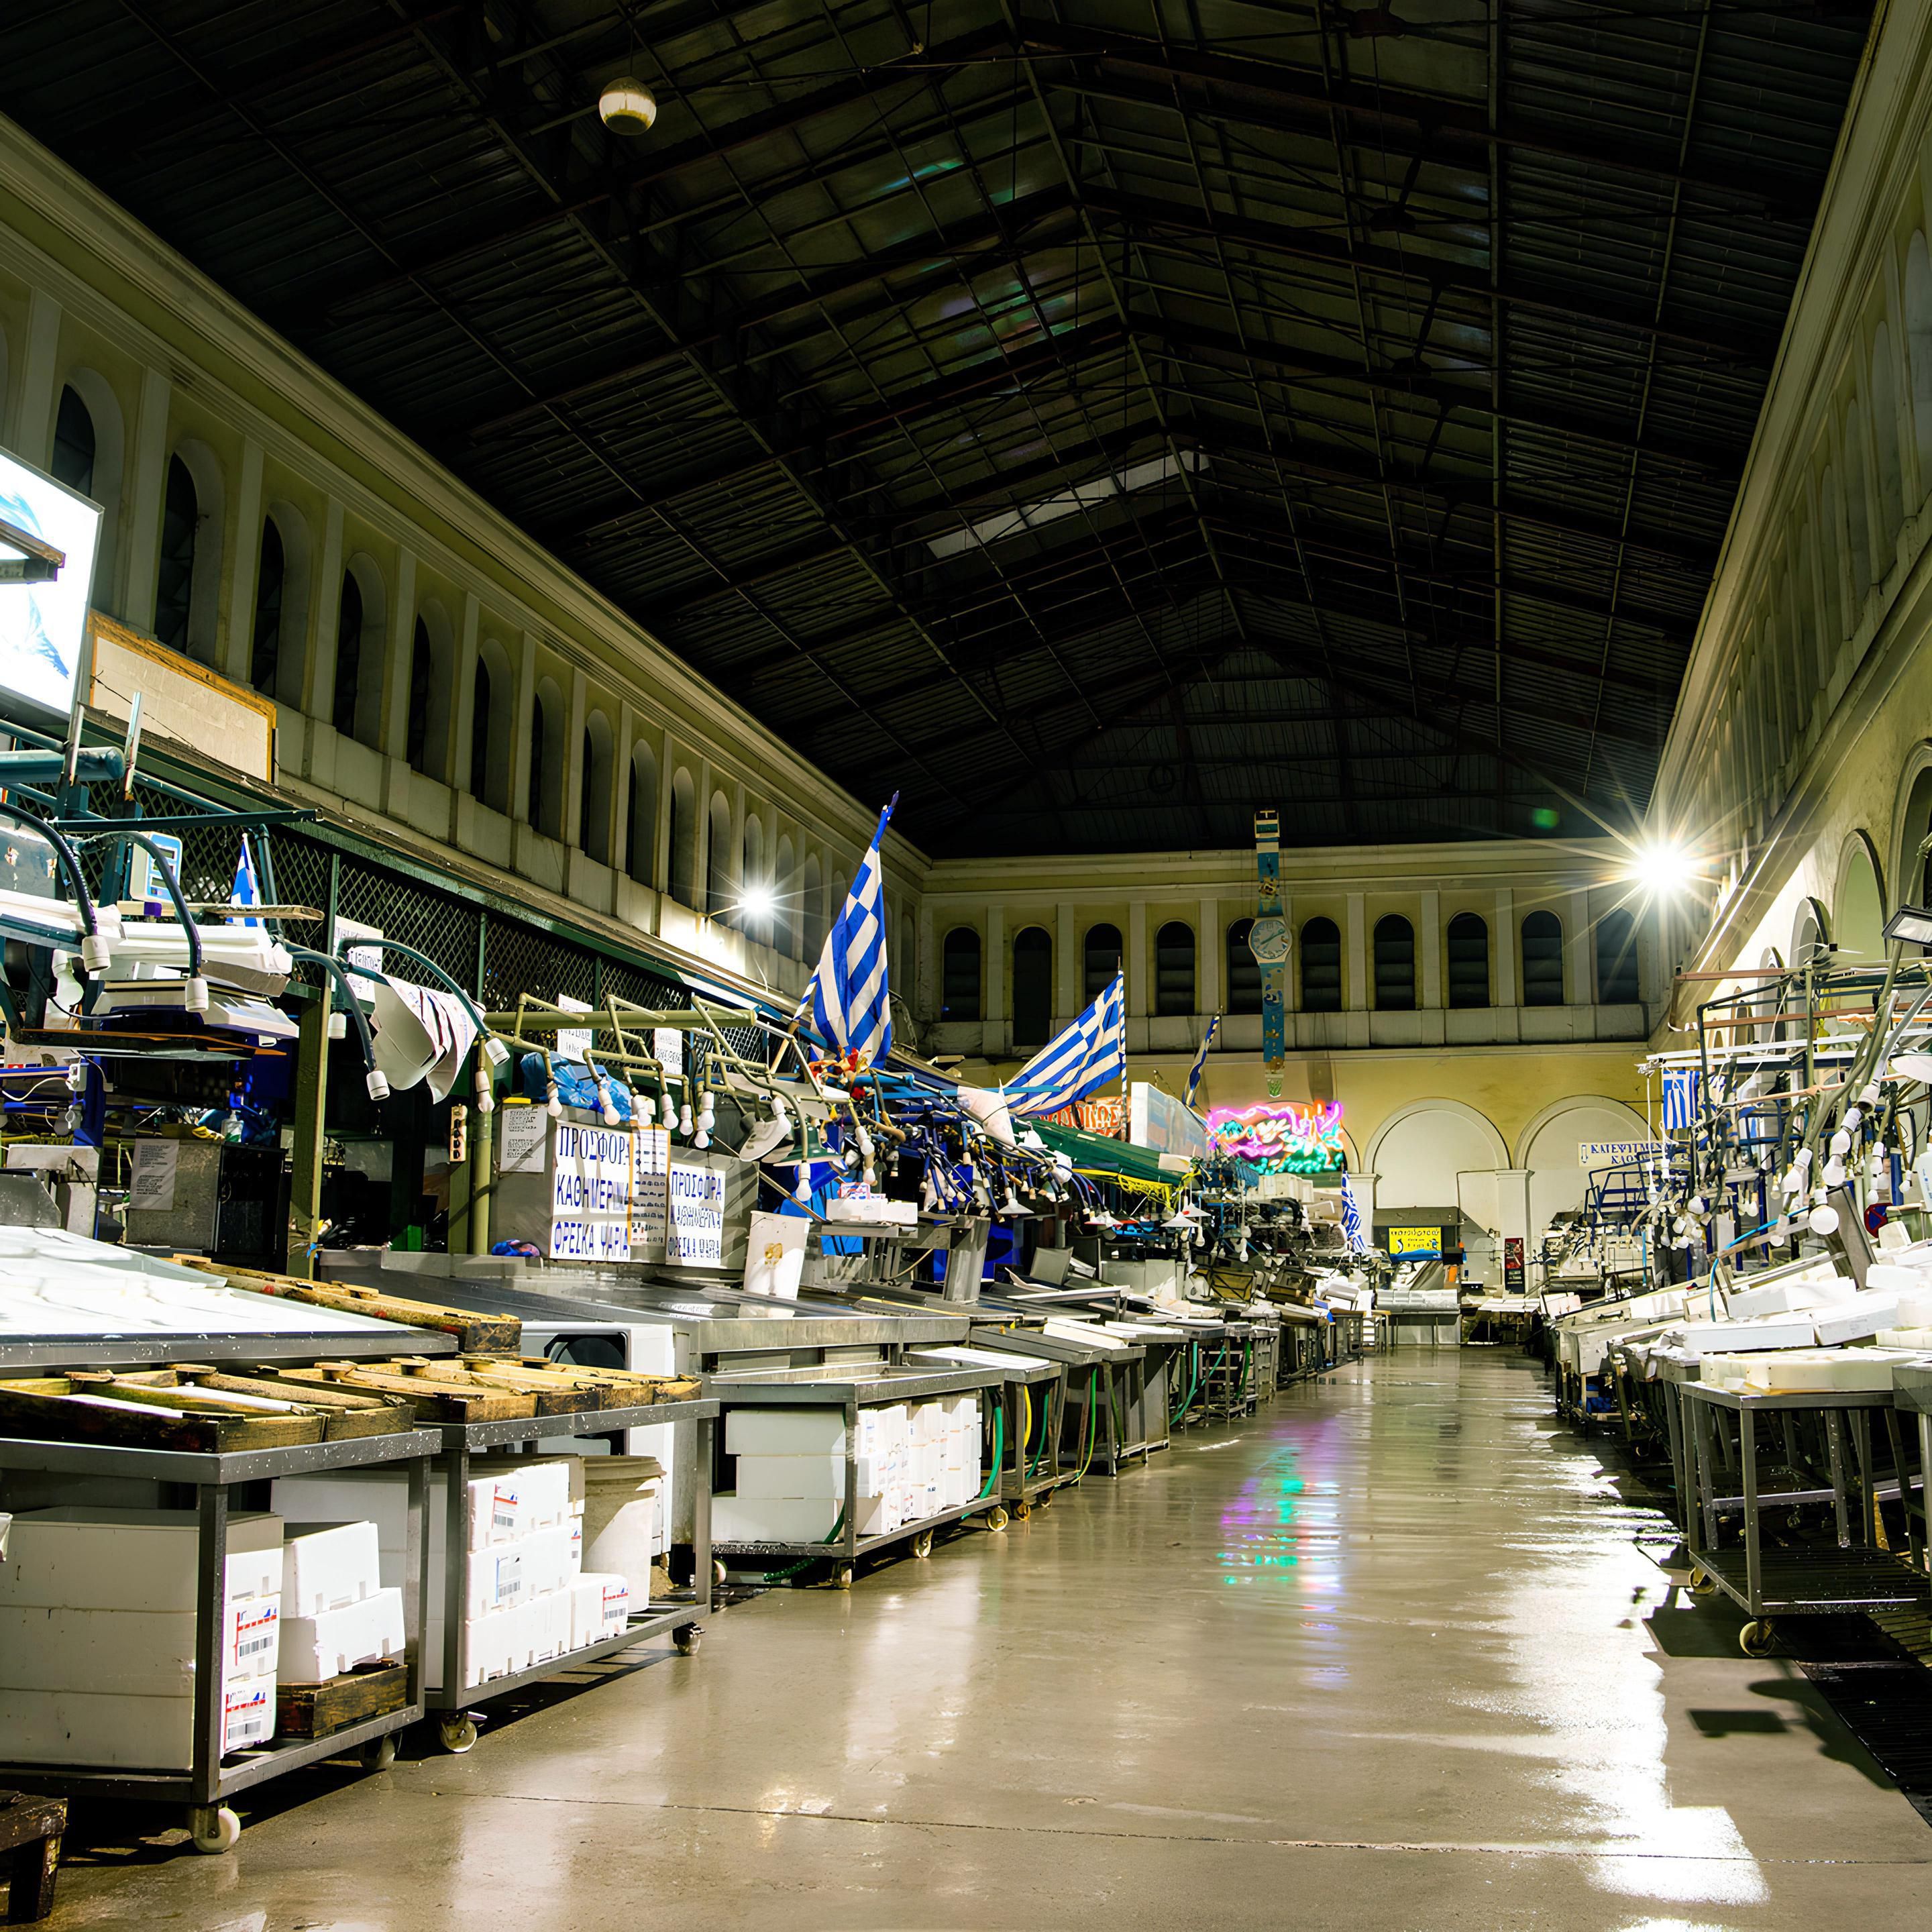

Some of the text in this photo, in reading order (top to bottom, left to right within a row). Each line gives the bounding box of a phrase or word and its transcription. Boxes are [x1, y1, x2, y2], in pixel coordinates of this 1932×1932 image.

[671, 1171, 722, 1201] ΠΡΟΣΦΟΡΑ
[554, 1221, 629, 1258] ΦΡΕΣΚΑ ΨΑΡΙΑ
